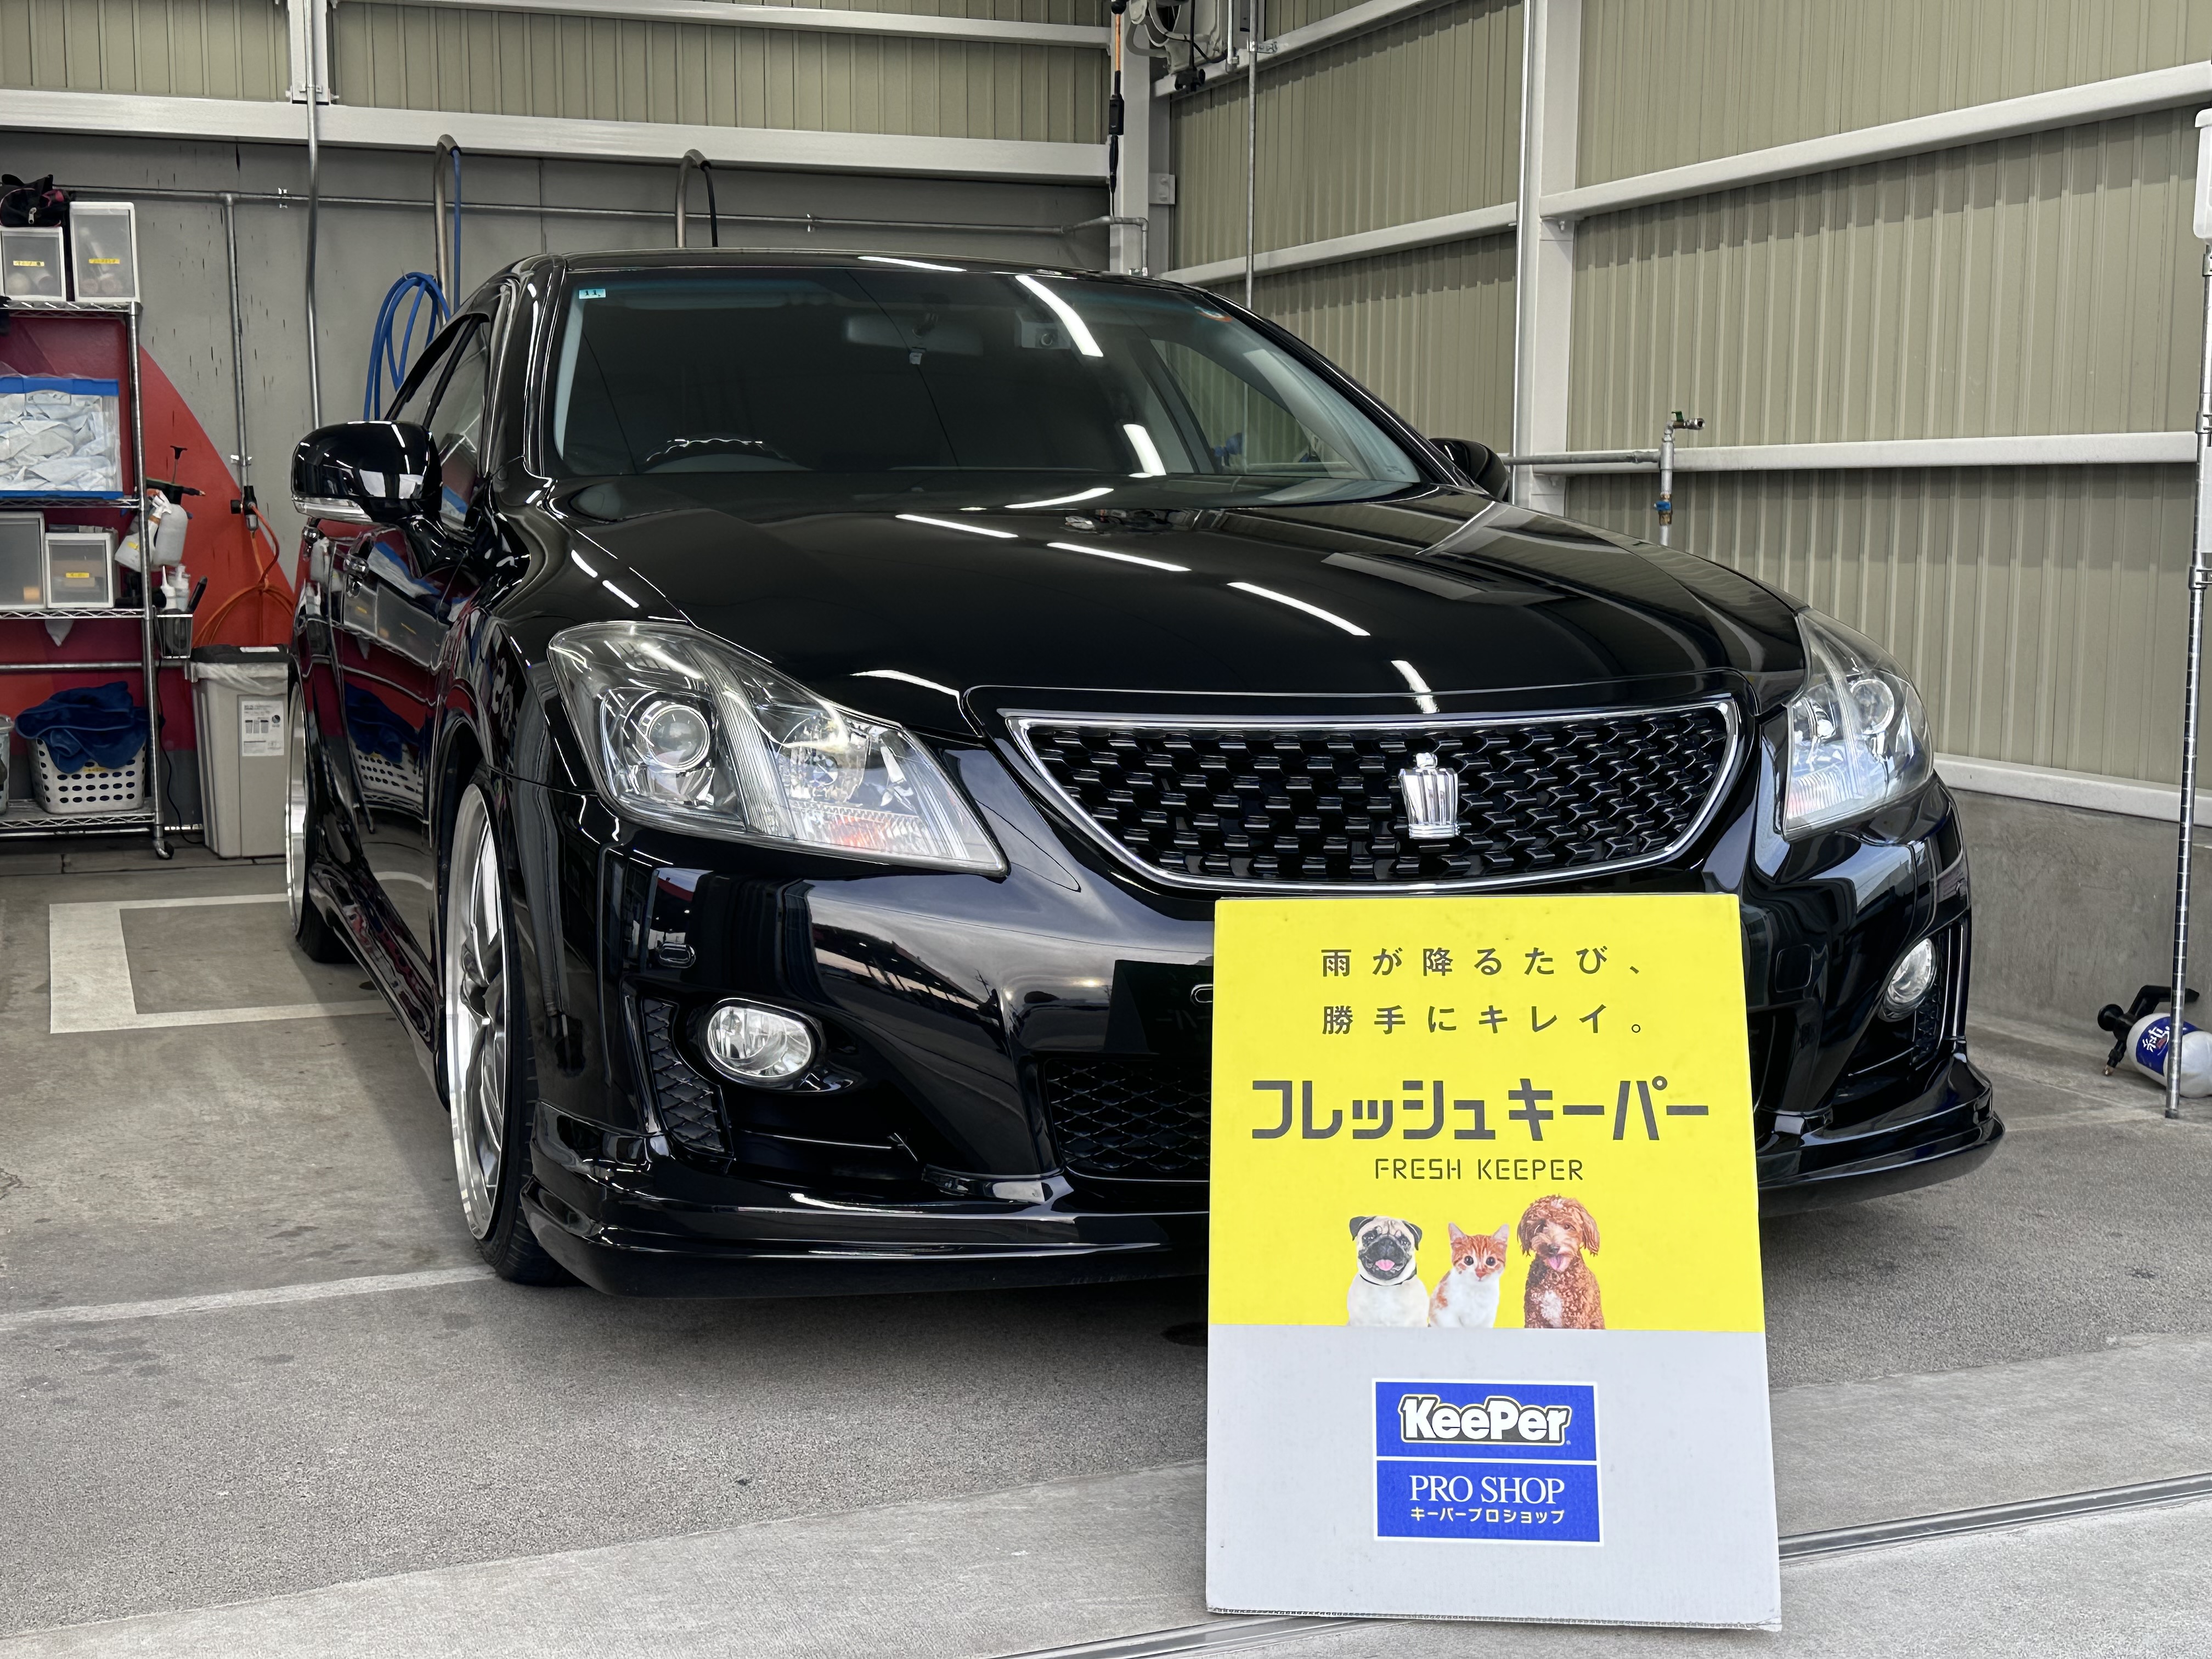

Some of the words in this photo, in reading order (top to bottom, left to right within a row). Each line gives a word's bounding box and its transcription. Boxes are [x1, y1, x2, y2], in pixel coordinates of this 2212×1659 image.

[1321, 946, 1639, 977] 雨が降るたび、
[1322, 1004, 1641, 1035] 勝手にキレイ。
[1252, 1076, 1709, 1141] フレッシュキーパー
[1375, 1158, 1461, 1180] FRESH
[1477, 1159, 1583, 1181] KEEPER
[1402, 1398, 1569, 1441] KeePer
[1409, 1475, 1473, 1502] PRO
[1481, 1476, 1565, 1504] SHOP
